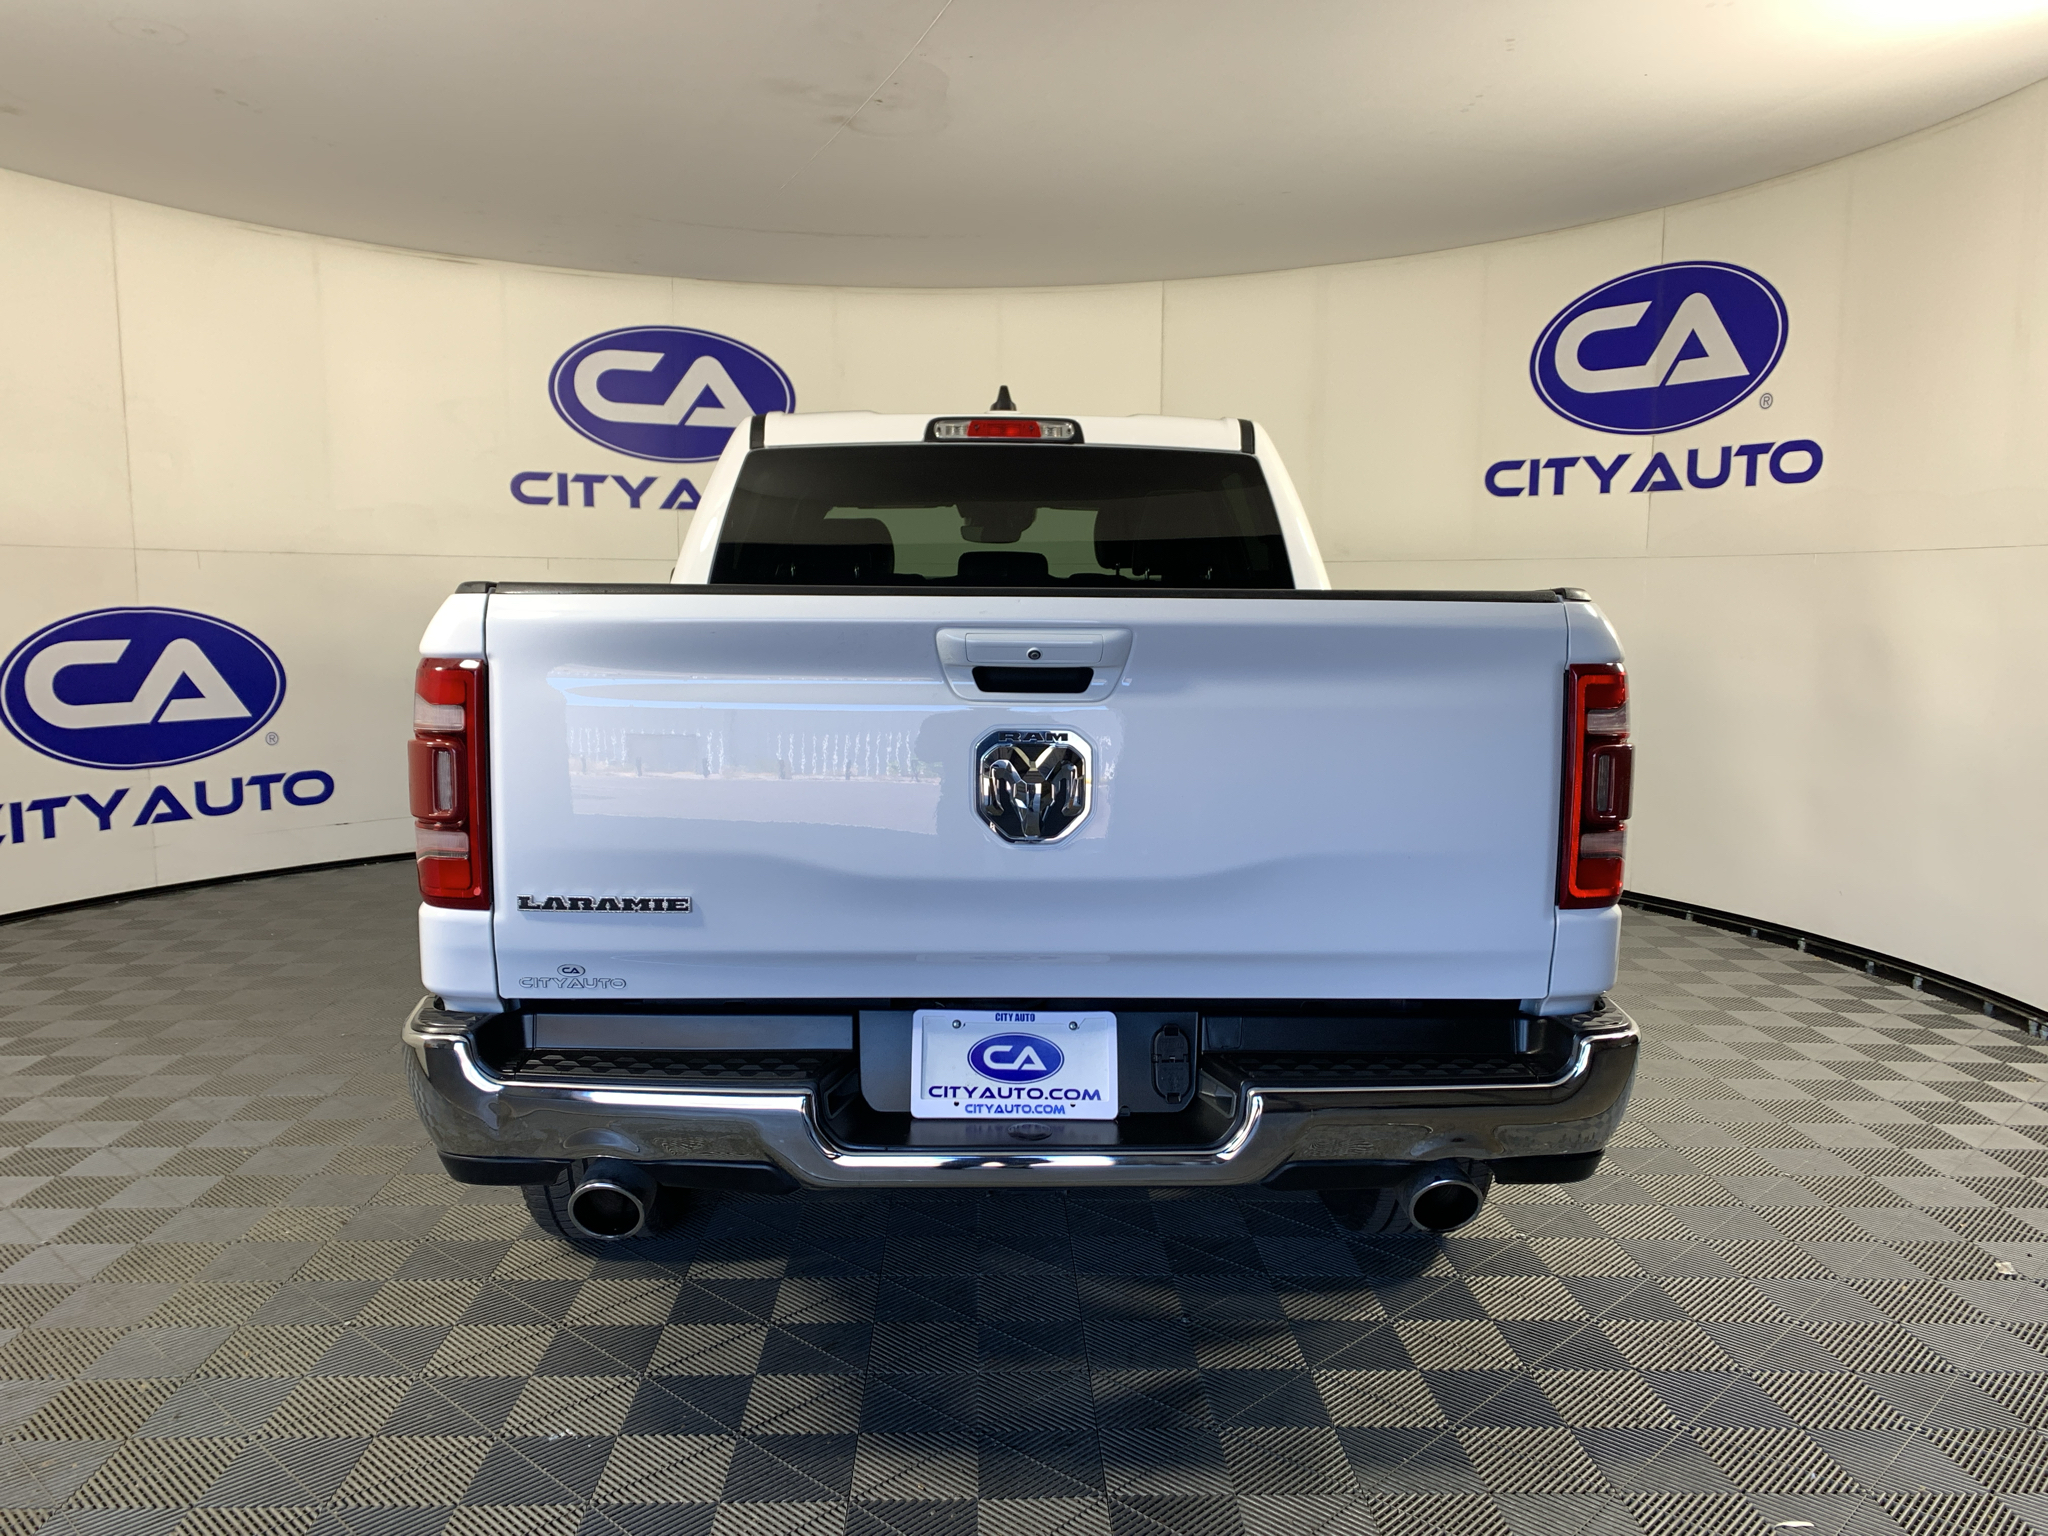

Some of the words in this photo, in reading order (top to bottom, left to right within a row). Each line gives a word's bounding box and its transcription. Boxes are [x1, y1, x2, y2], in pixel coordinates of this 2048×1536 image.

[1554, 292, 1751, 394] CA
[573, 349, 757, 428] CA
[24, 637, 252, 729] CA
[998, 732, 1069, 742] RAM
[0, 769, 335, 847] ITYAUTO
[517, 894, 693, 914] LARAMIE
[561, 966, 580, 974] CA
[994, 1012, 1014, 1022] CITY
[1014, 1012, 1036, 1023] AUTO
[983, 1045, 1047, 1071] CA
[928, 1085, 1102, 1102] CITYAUTO.COM
[964, 1103, 1066, 1115] CITYAUTO.COM
